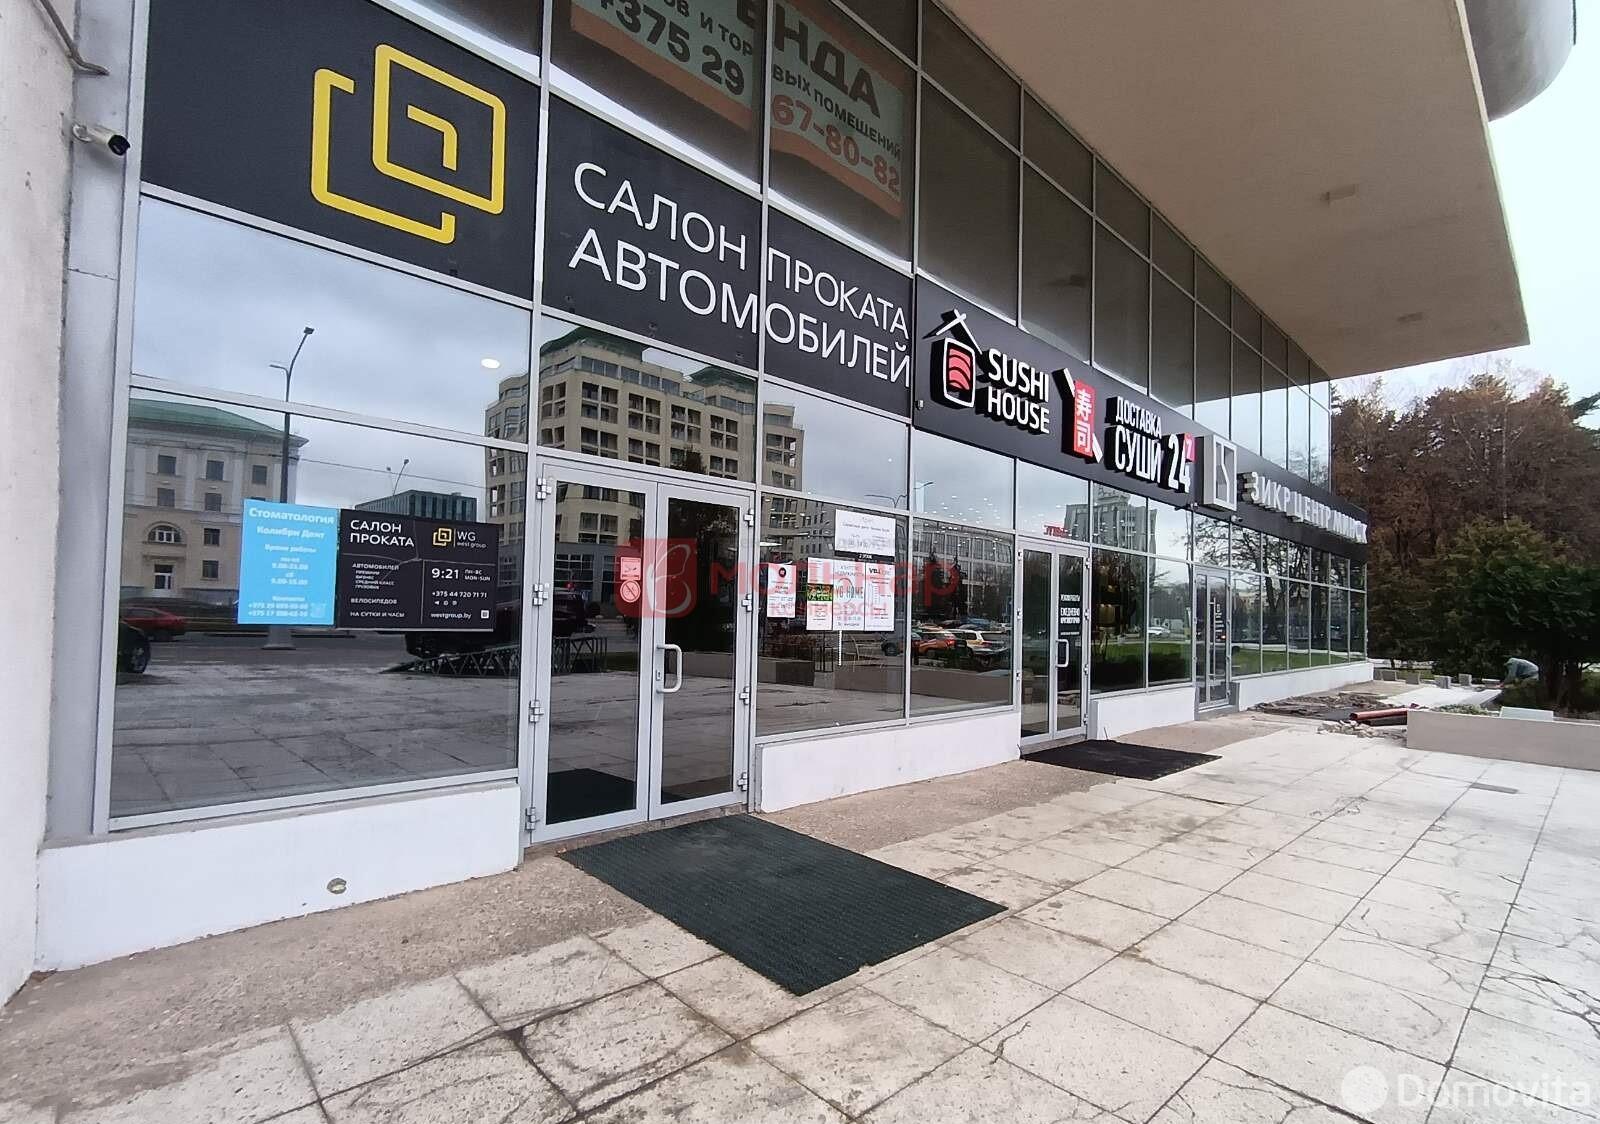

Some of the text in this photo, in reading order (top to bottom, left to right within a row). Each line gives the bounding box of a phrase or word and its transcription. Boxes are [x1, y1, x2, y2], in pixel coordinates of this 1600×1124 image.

[700, 12, 713, 34] И
[702, 45, 744, 95] 29
[574, 162, 909, 339] САЛОН ПРОКАТА
[568, 228, 911, 388] АВТОМОБИЛЕЙ
[988, 348, 1049, 402] SUSHI
[988, 386, 1049, 434] HOUSE
[1116, 396, 1162, 439] ДОСТАВКА
[1115, 424, 1191, 493] СУШИ 24
[249, 508, 335, 524] Стоматология
[1249, 471, 1290, 513] ЗИКР
[1291, 491, 1330, 528] ЦЕНТР
[350, 519, 402, 533] САЛОН
[350, 533, 415, 547] ПРОКАТА
[457, 531, 477, 542] WG
[352, 563, 400, 571] АВТОМОБИЛЕЙ
[431, 567, 459, 579] 9:21
